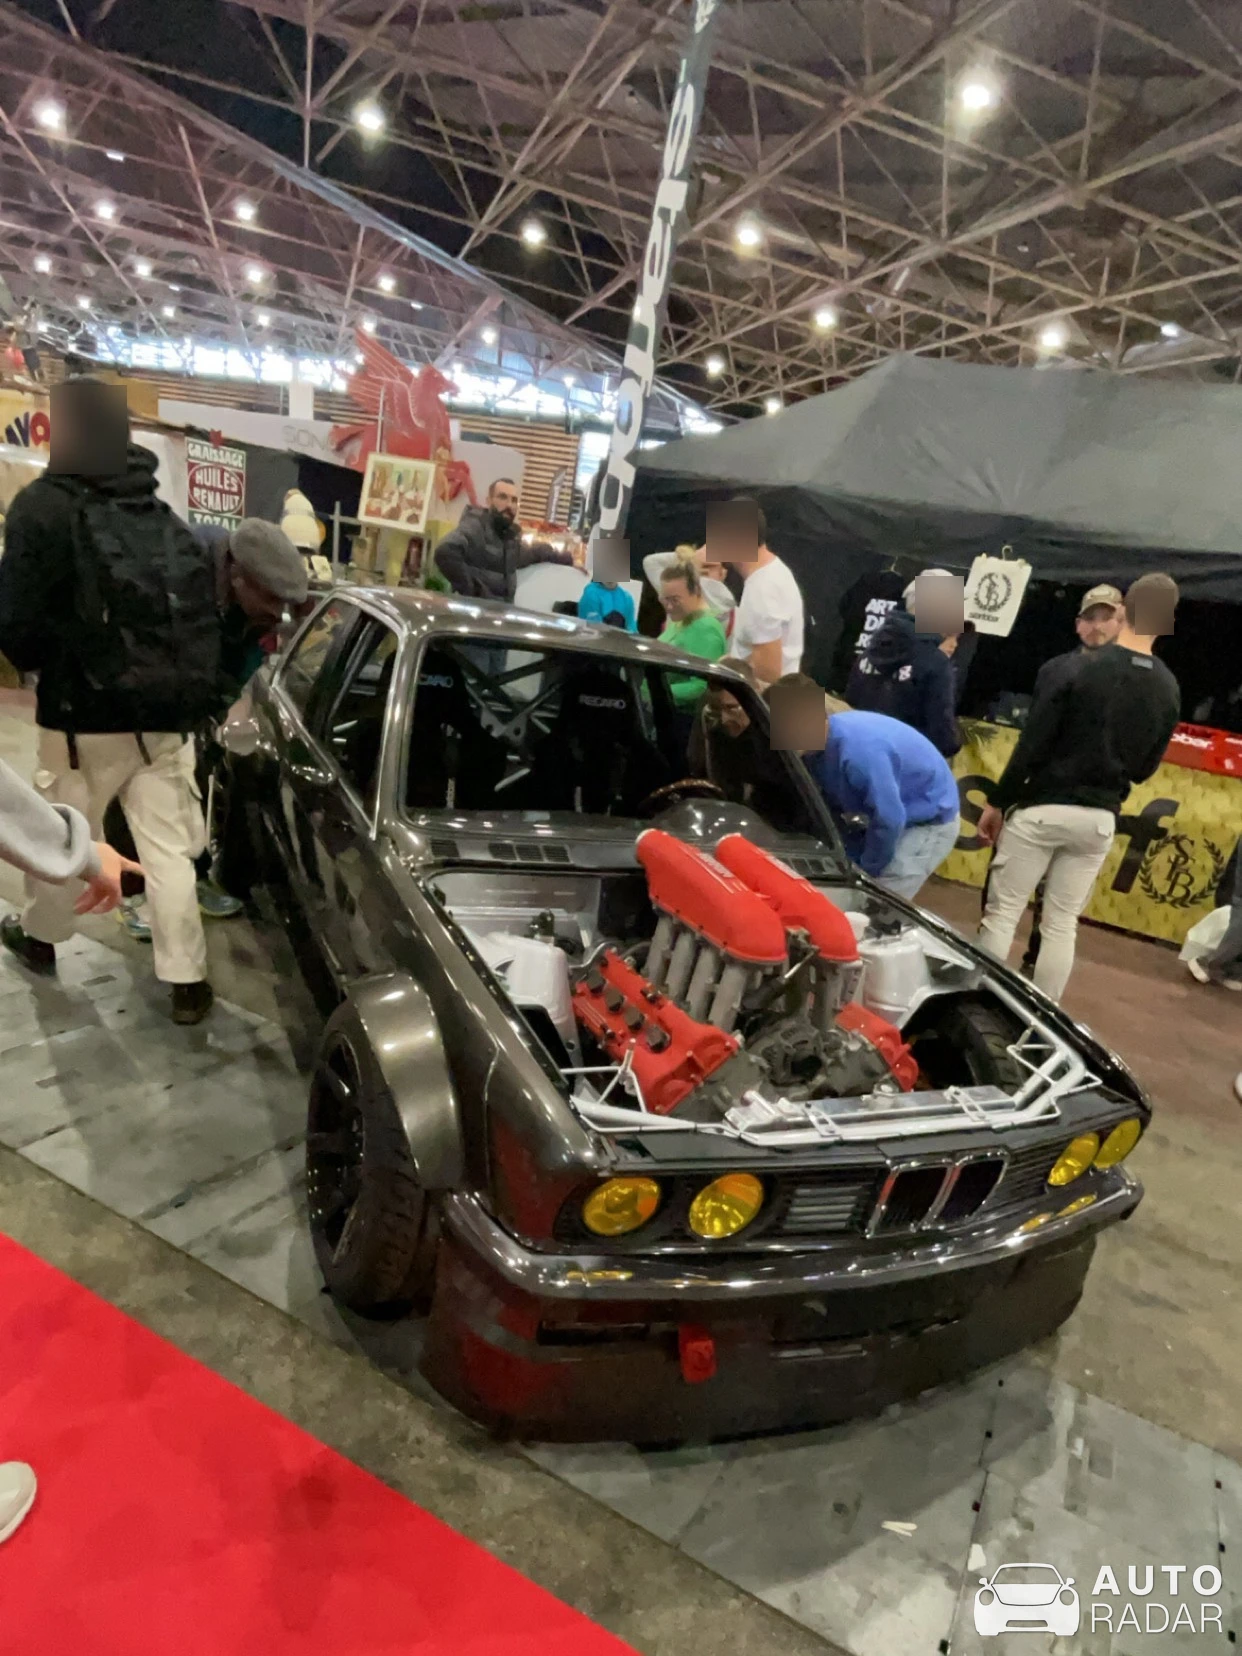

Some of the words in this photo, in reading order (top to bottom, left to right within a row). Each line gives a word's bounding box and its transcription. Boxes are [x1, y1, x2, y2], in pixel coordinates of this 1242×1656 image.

[599, 83, 694, 531] starfob
[195, 467, 239, 493] HUILES
[193, 486, 240, 513] RENAULT
[865, 598, 898, 615] ART
